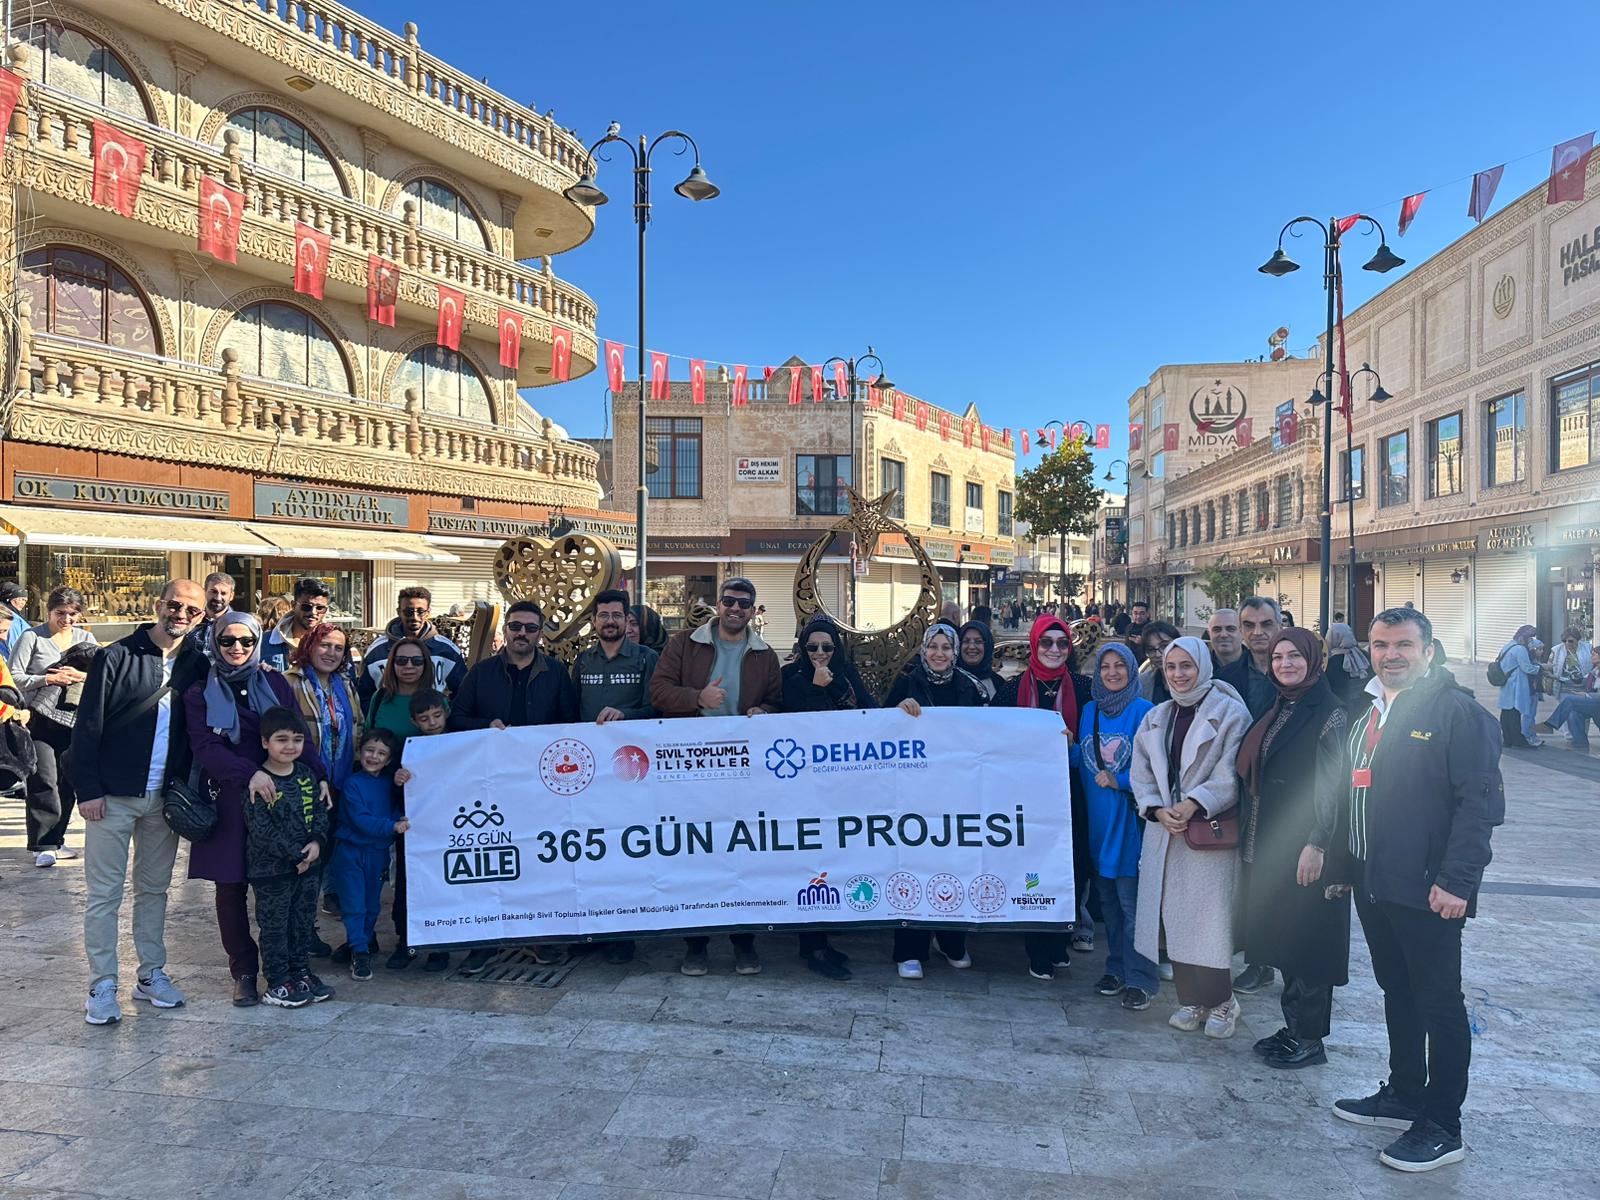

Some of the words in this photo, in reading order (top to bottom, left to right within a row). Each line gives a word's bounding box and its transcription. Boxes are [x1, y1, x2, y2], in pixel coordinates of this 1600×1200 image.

[18, 480, 52, 498] OK
[73, 484, 227, 511] KUYUMCULUK
[286, 489, 379, 510] AYDINLAR
[271, 502, 394, 525] KUYUMCULUK
[429, 516, 477, 531] KUSTAN
[584, 521, 637, 536] KUYUMCULU
[1589, 528, 1600, 538] PA
[1274, 546, 1292, 561] AYA
[656, 749, 684, 759] SİVİL
[687, 745, 749, 758] TOPLUMLA
[812, 740, 927, 763] DEHADER
[657, 757, 750, 771] İLİŞKİLER
[813, 765, 839, 774] DEĞERLİ
[841, 764, 872, 772] HAYATLAR
[898, 761, 928, 769] DERNEĞİ
[448, 832, 474, 848] 365
[480, 830, 512, 845] GÜN
[536, 827, 606, 863] 365
[621, 815, 713, 859] GÜN
[727, 811, 822, 852] AİLE
[837, 804, 1025, 848] PROJESİ
[450, 849, 514, 879] AİLE
[1011, 897, 1056, 905] YEŞİLYURT
[437, 919, 457, 927] Proje
[474, 915, 500, 924] İçişleri
[502, 912, 535, 921] Bakanlığı
[537, 911, 553, 919] Sivil
[555, 910, 587, 919] Toplumla
[588, 908, 615, 917] İlişkiler
[616, 907, 638, 915] Genel
[640, 905, 679, 913] Müdürlüğü
[680, 902, 719, 910] Tarafından
[720, 899, 789, 908] Desteklenmektedir.
